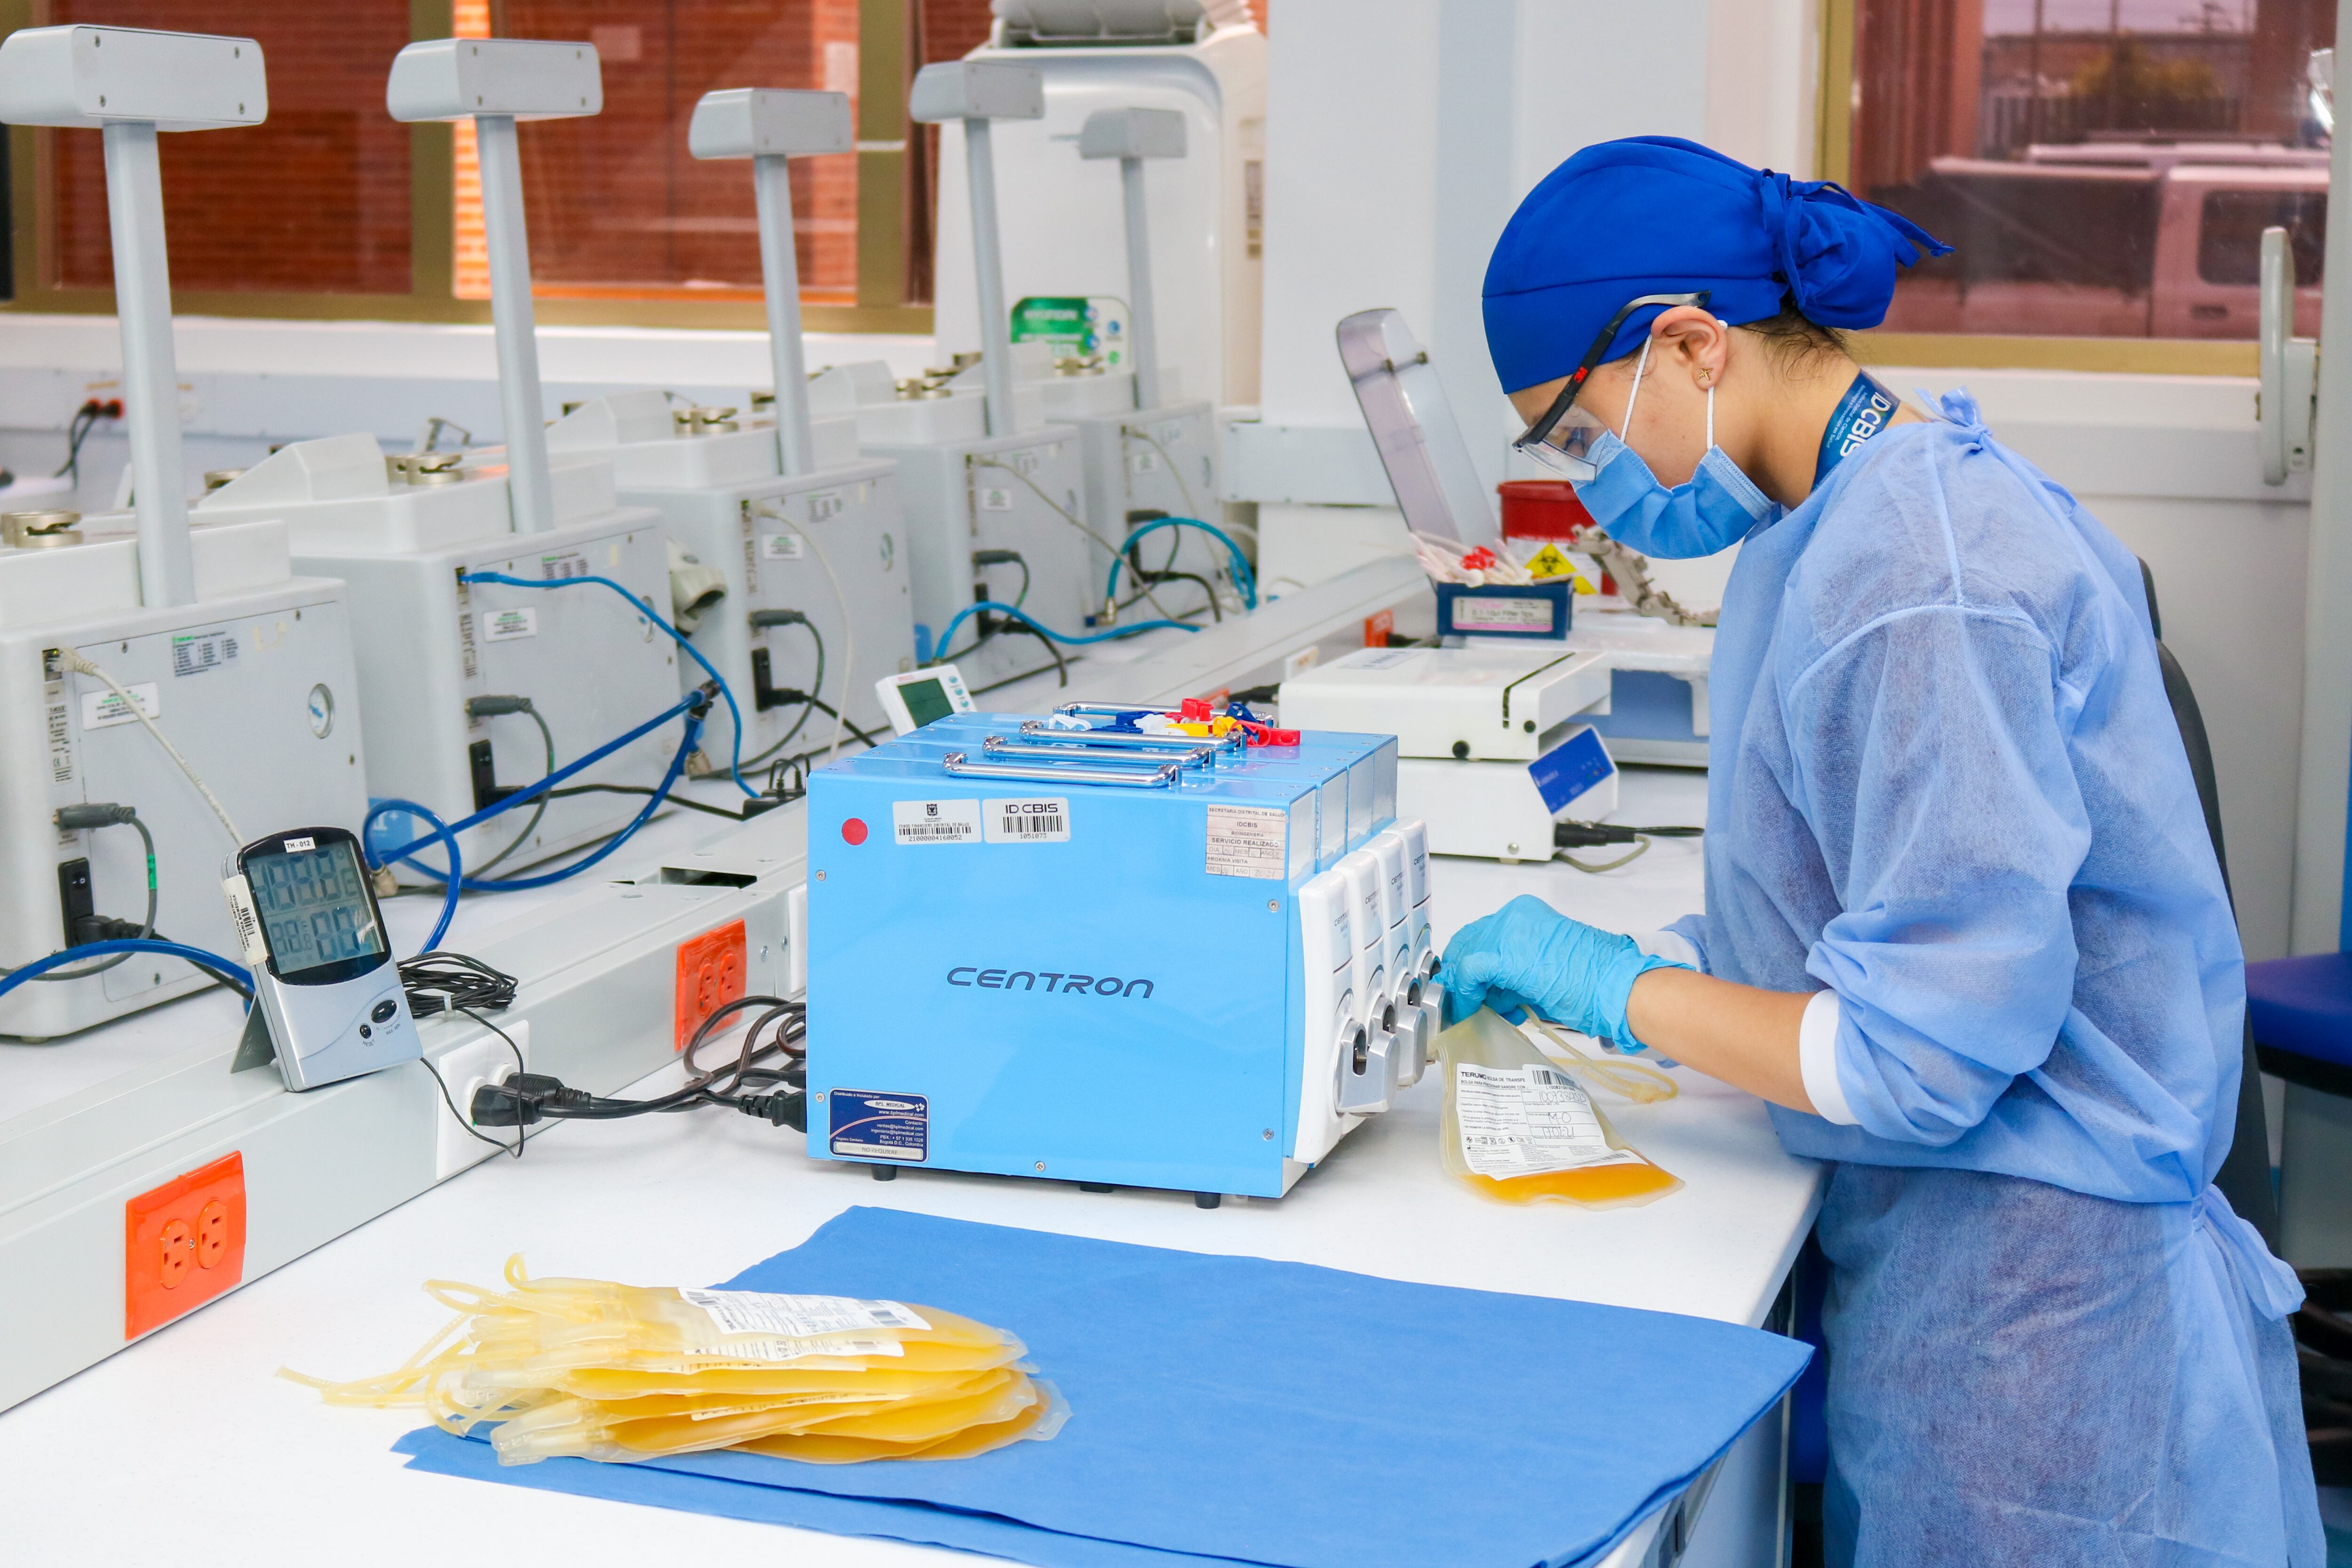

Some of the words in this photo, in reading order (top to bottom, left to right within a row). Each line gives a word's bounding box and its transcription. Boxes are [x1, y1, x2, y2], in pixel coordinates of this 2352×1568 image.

[1006, 804, 1019, 814] ID
[1022, 803, 1058, 813] CBIS
[235, 920, 247, 951] HEMOCENTRO
[947, 967, 1154, 998] CENTRON
[363, 1038, 375, 1047] RESET
[1461, 1071, 1486, 1080] TERUMO
